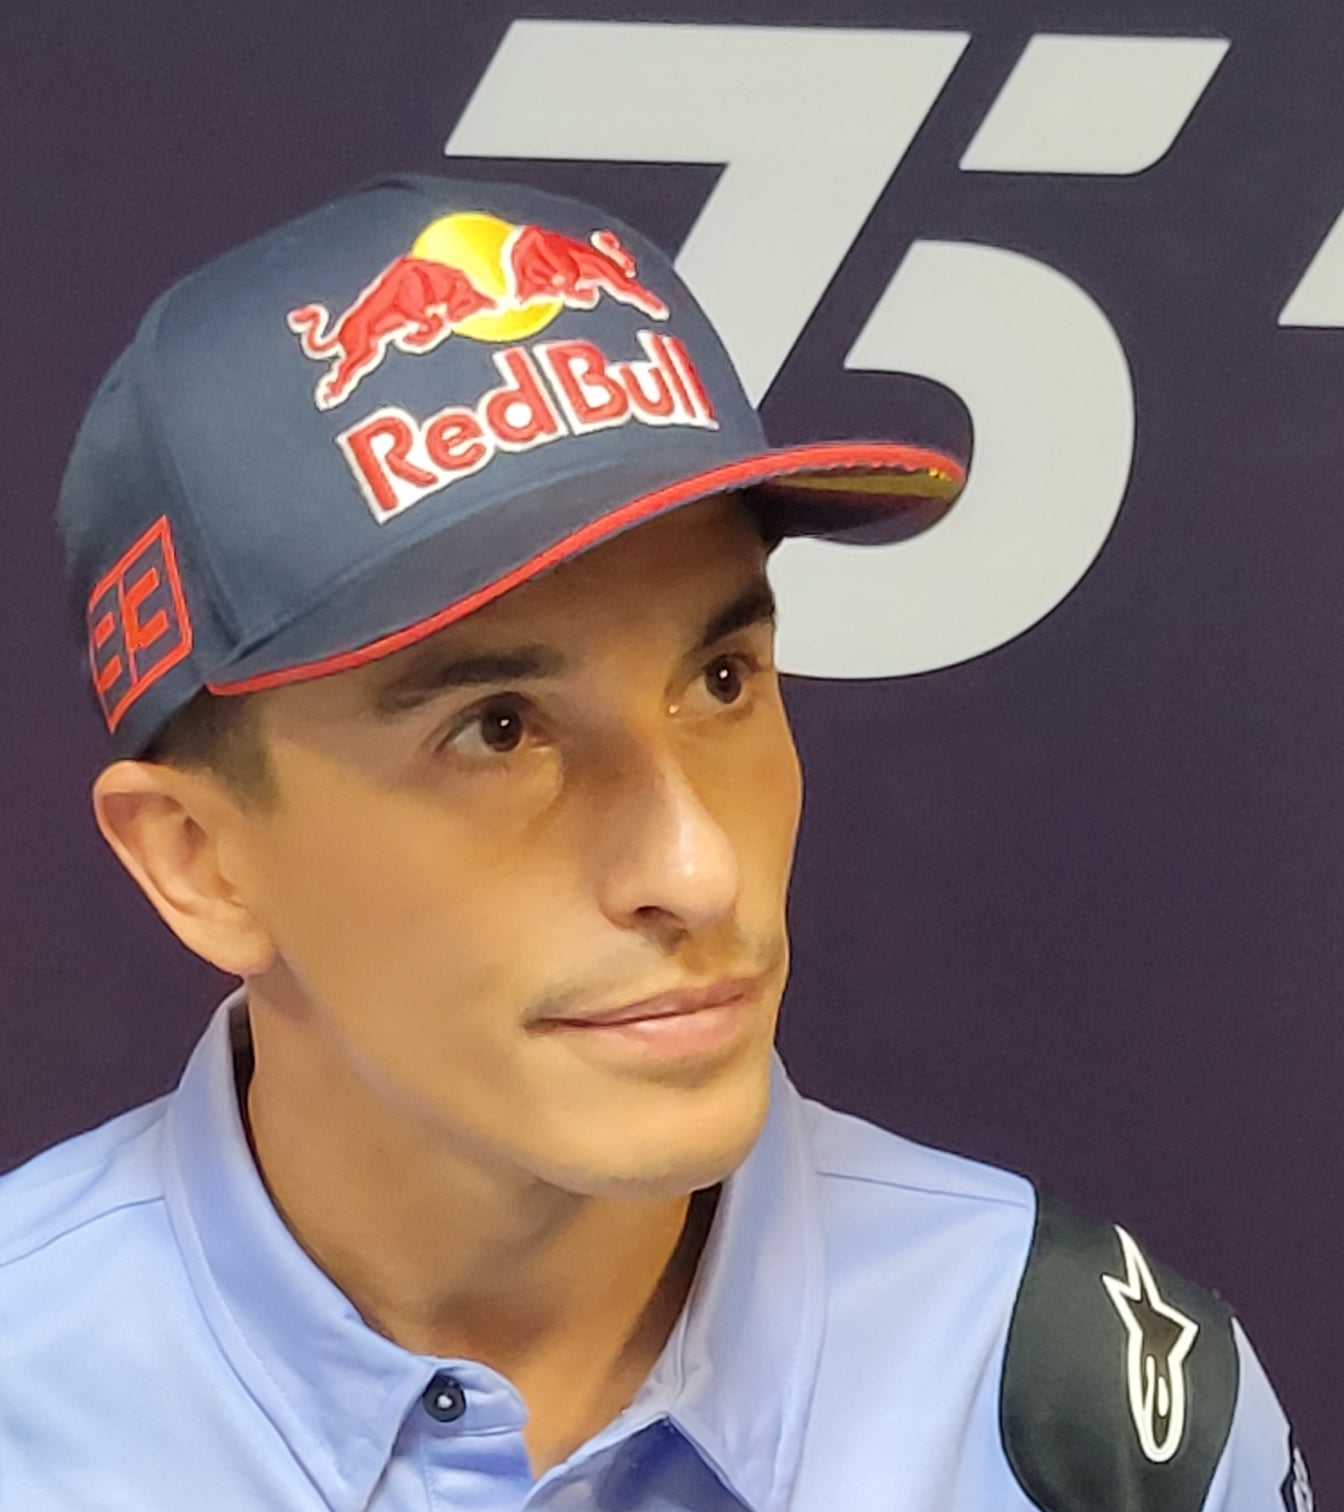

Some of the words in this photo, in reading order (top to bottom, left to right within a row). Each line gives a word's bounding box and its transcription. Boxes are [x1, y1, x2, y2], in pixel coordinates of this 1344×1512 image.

[337, 346, 565, 522] Red
[535, 330, 718, 432] Bull
[445, 20, 1232, 680] 75
